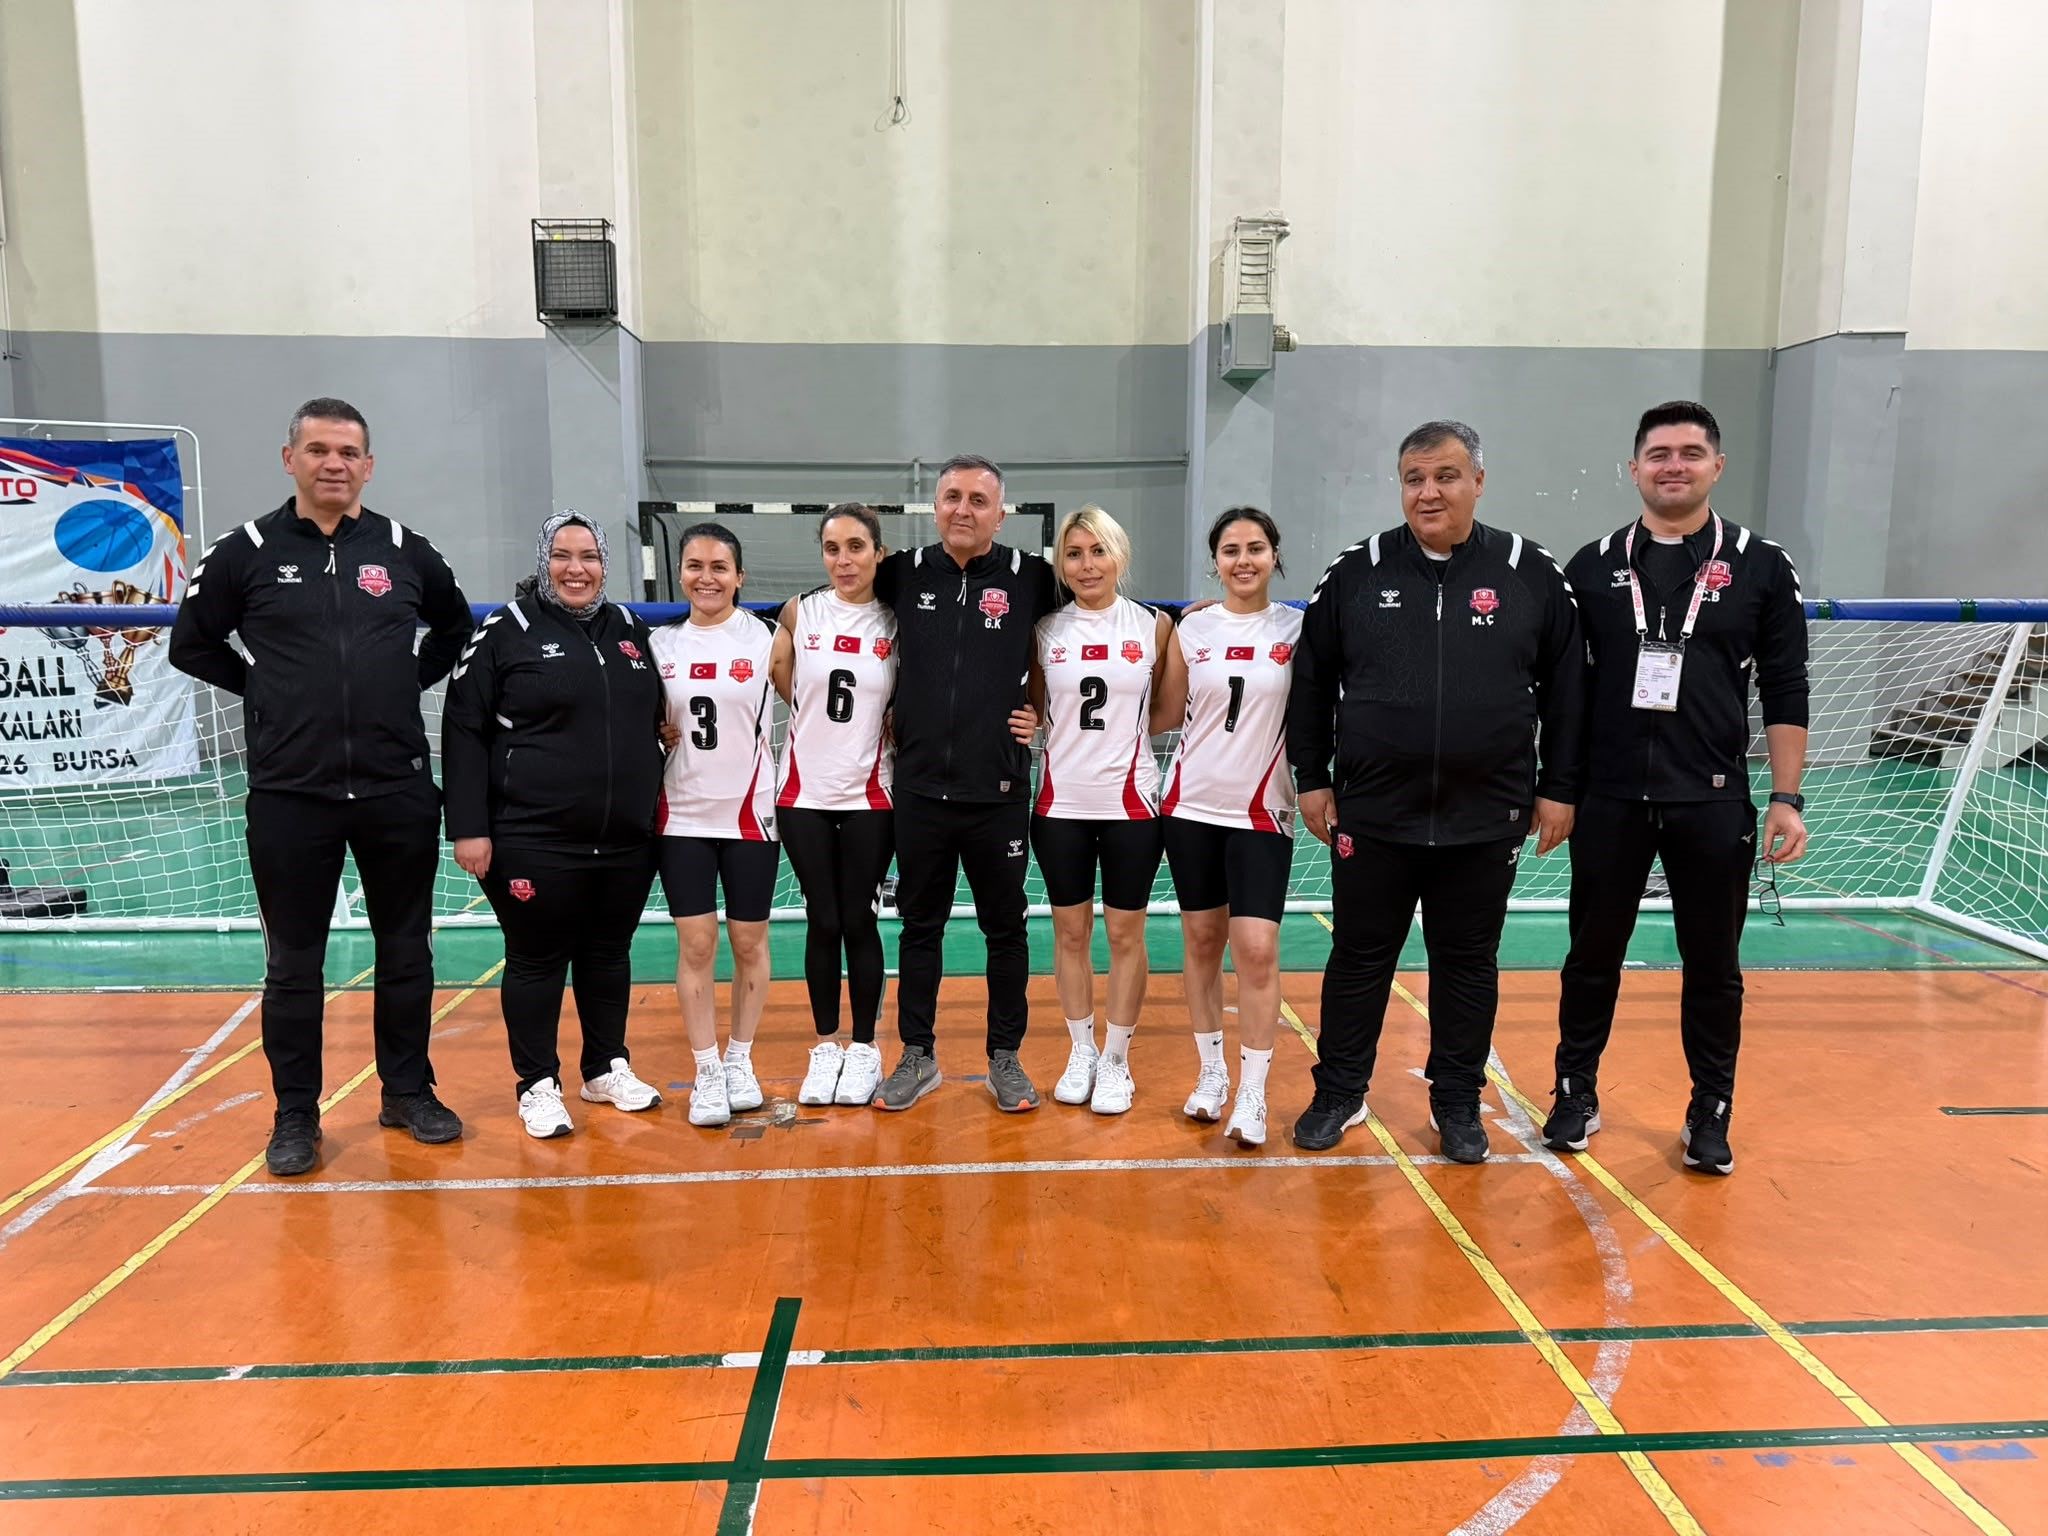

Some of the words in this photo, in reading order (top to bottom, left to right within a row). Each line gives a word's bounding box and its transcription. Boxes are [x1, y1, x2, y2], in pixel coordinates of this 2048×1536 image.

[0, 478, 37, 497] TO
[984, 618, 1001, 629] G.K
[689, 695, 718, 751] 3
[826, 668, 857, 724] 6
[1080, 676, 1108, 731] 2
[1224, 676, 1245, 733] 1
[53, 748, 138, 772] BURSA
